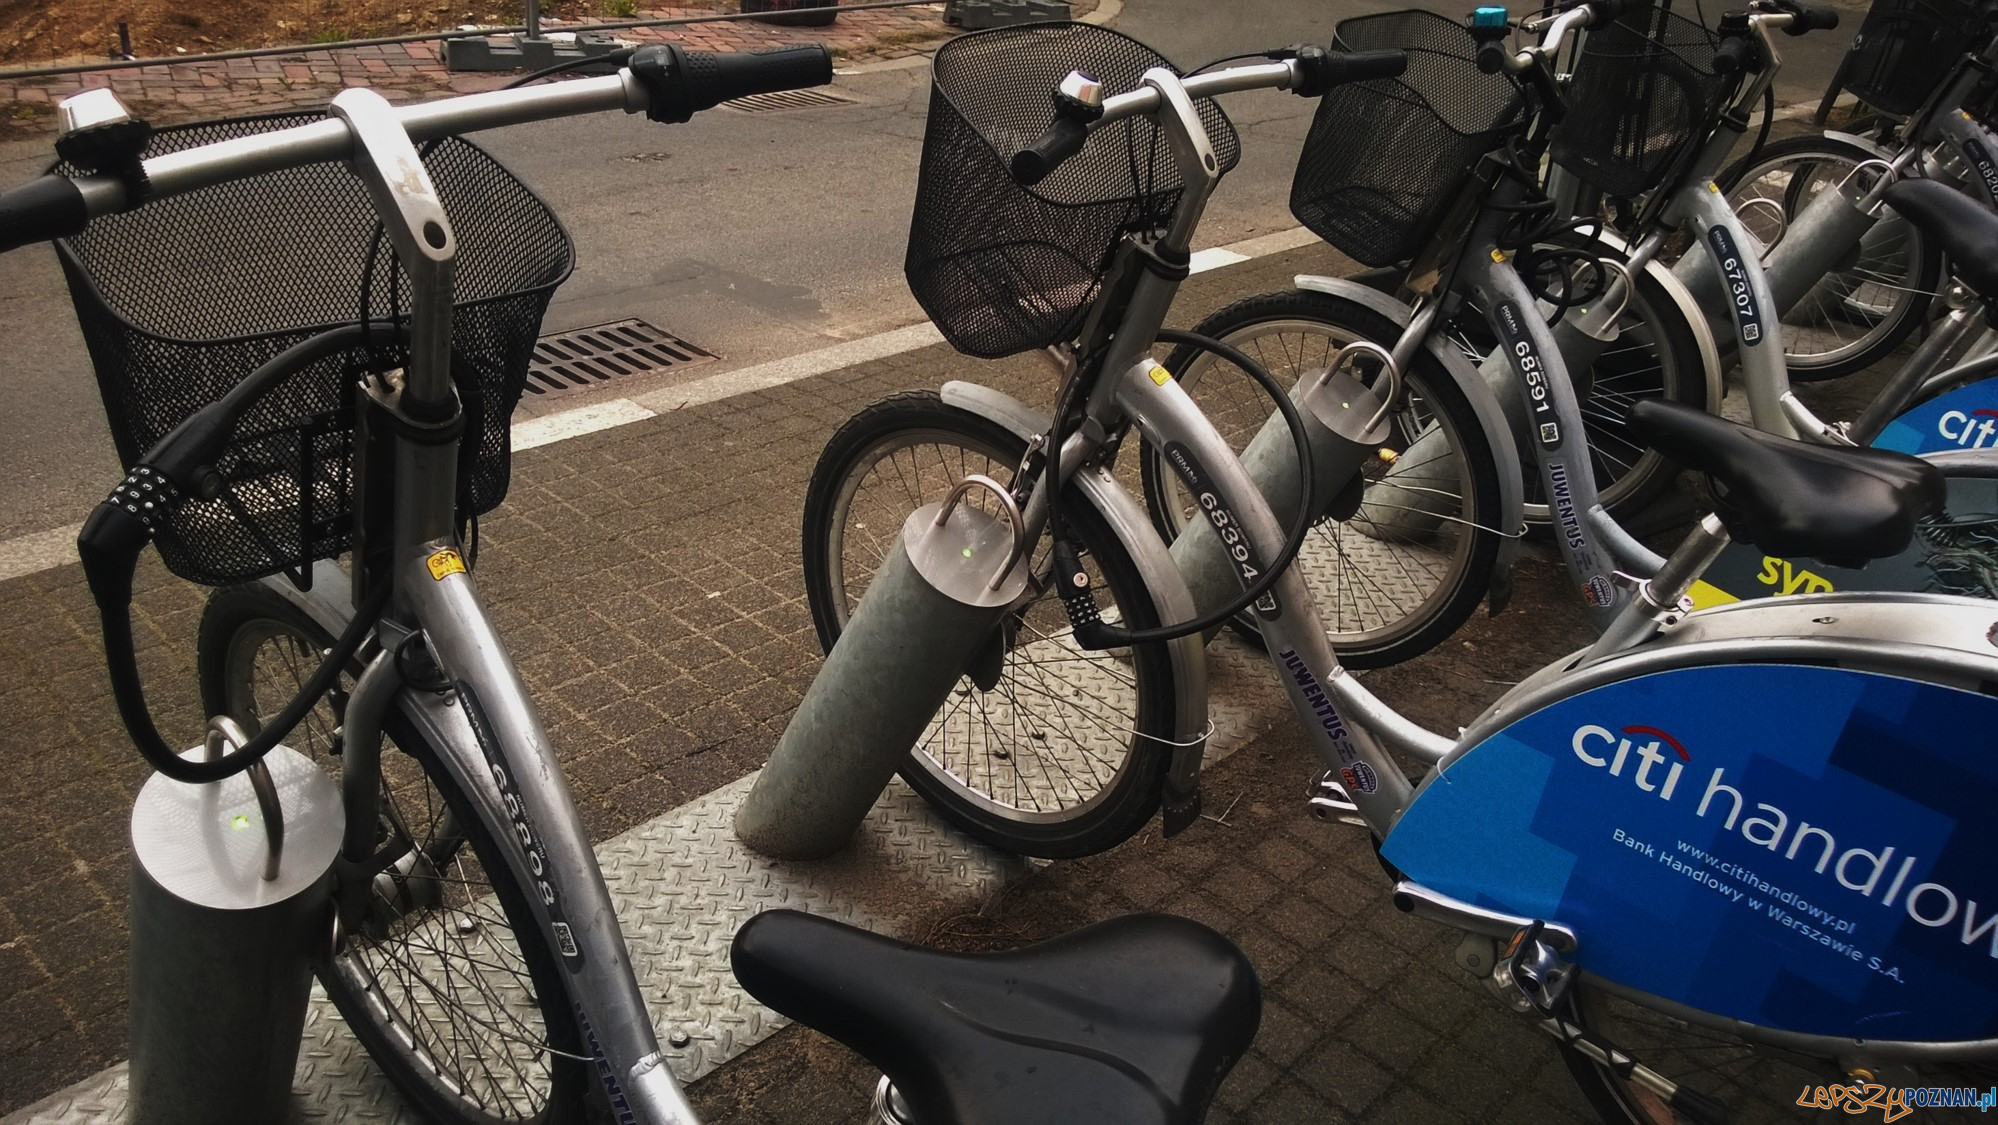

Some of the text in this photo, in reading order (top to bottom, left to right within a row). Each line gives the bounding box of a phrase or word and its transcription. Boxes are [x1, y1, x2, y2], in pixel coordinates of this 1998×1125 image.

[1724, 258, 1753, 316] 67307
[1515, 341, 1550, 413] 68591
[1938, 409, 1998, 449] cit
[1200, 492, 1259, 582] 68394
[1547, 462, 1586, 549] JUWENTUS
[1279, 649, 1347, 740] JUWENTUS
[1572, 724, 1684, 801] citi
[492, 764, 554, 905] 68808
[1612, 828, 1905, 984] Bank Handlowy w Warszawie S.A.
[1677, 839, 1857, 935] www.citihandlowy.pl
